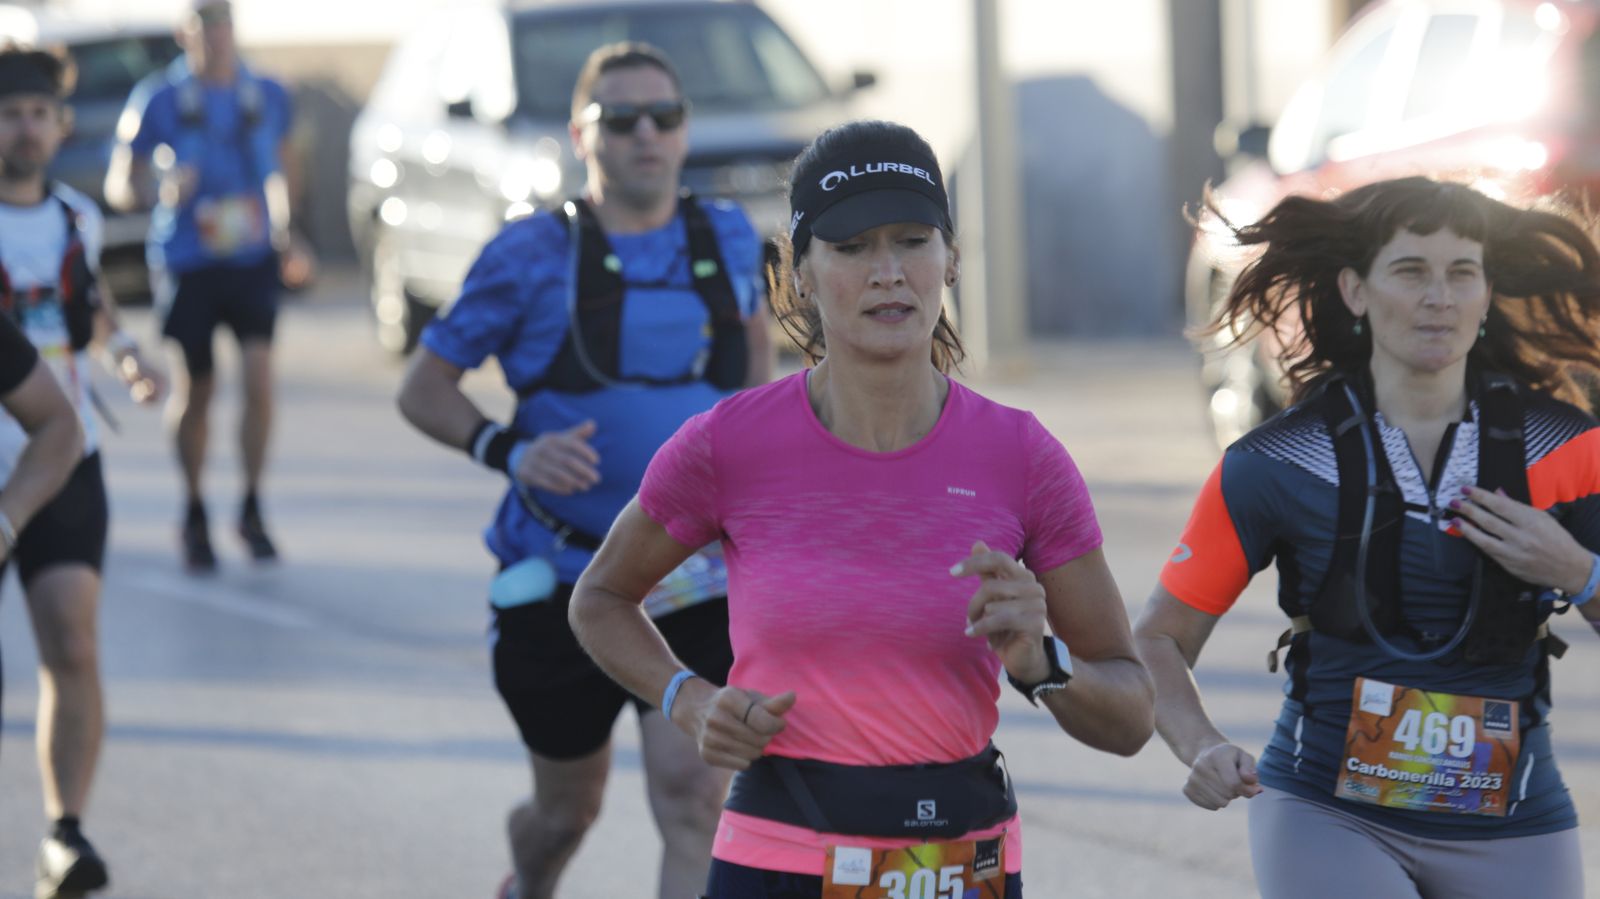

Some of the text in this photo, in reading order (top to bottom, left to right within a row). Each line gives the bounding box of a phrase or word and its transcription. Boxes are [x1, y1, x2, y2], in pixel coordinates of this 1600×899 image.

[850, 162, 936, 186] LURBEL
[1393, 709, 1476, 758] 469
[1346, 757, 1456, 788] Carbonerilla
[1459, 775, 1503, 790] 2023
[879, 865, 965, 899] 305
